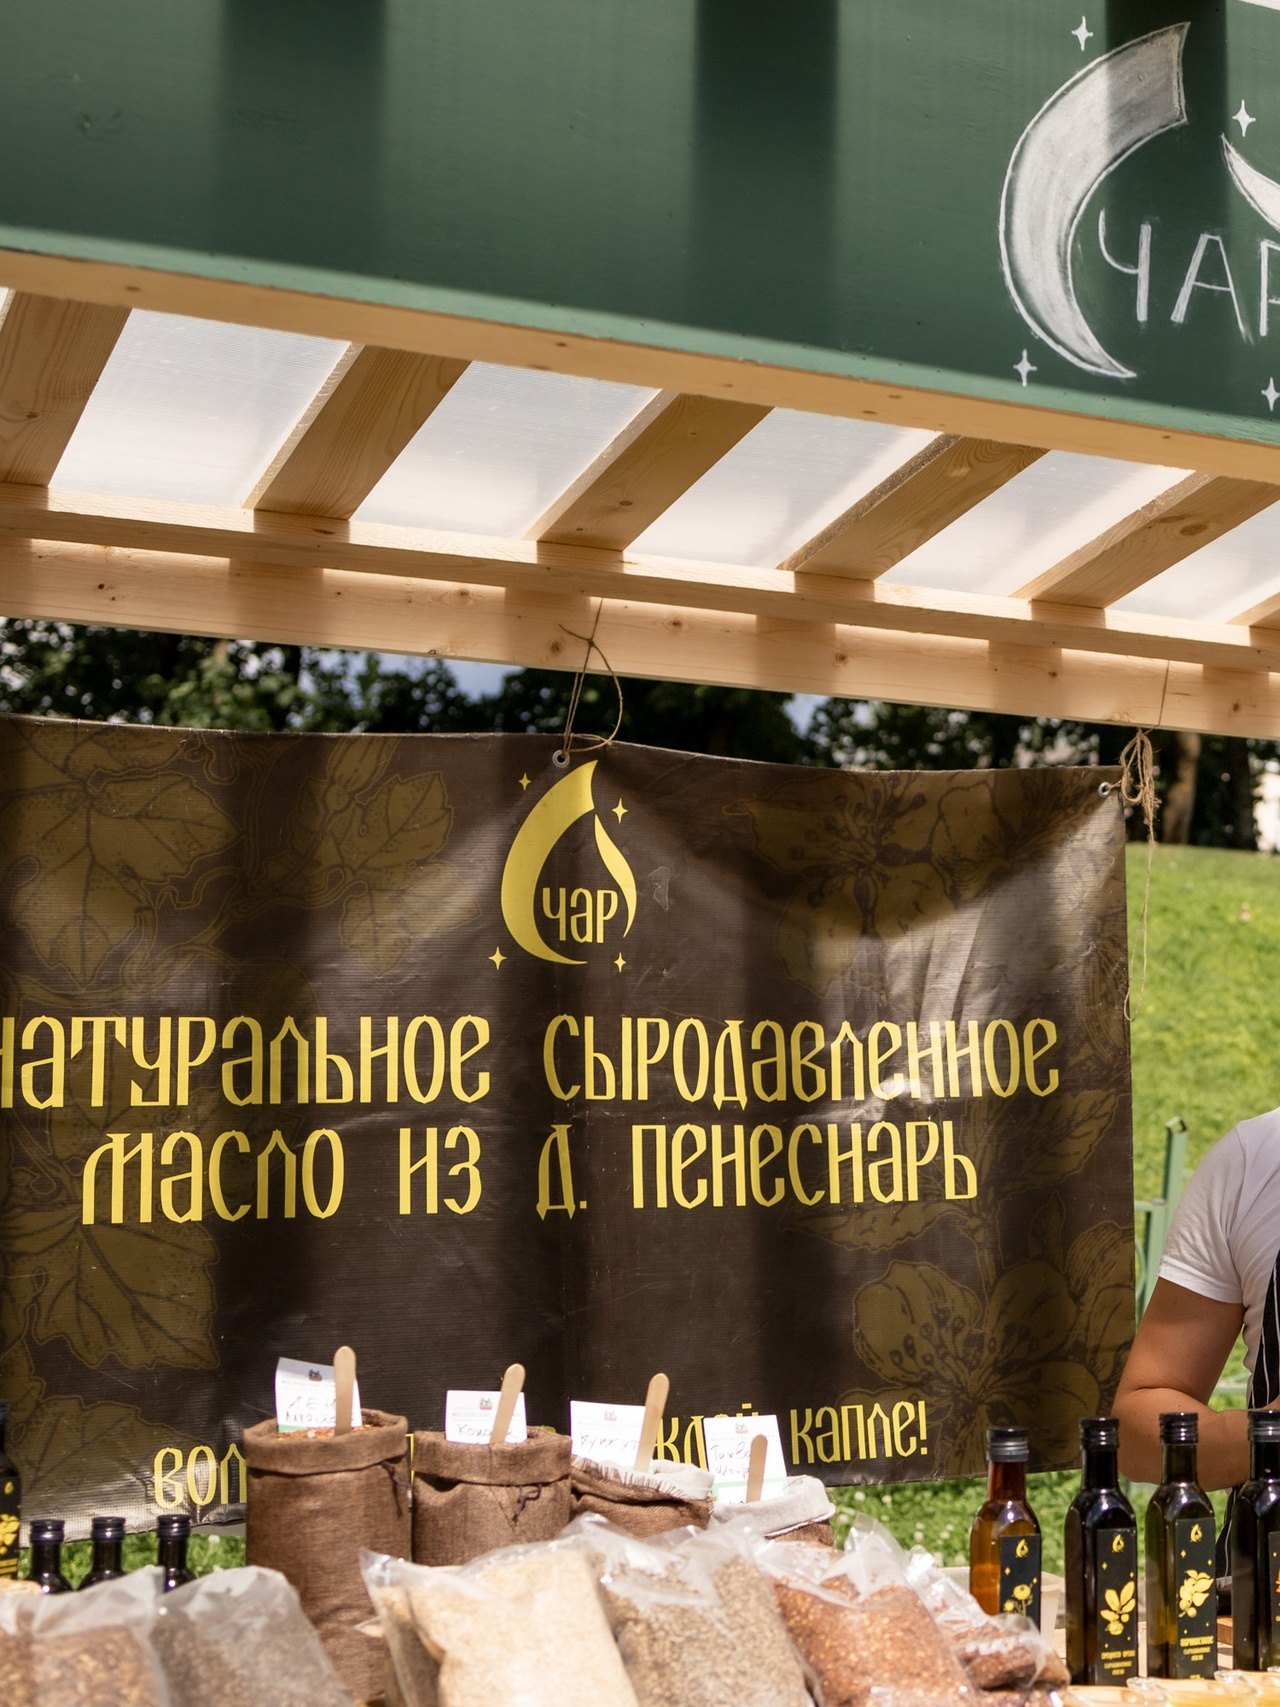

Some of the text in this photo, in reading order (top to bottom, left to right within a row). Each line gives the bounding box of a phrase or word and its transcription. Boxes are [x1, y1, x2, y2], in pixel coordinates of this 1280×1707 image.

[542, 887, 618, 943] ЧАР
[543, 1014, 1059, 1110] СЫРОДАВЛЕННОЕ
[82, 1120, 978, 1225] МАСЛО ИЗ Д. ПЕНЕСНАРЬ
[790, 1400, 928, 1465] КАПЛЕ!
